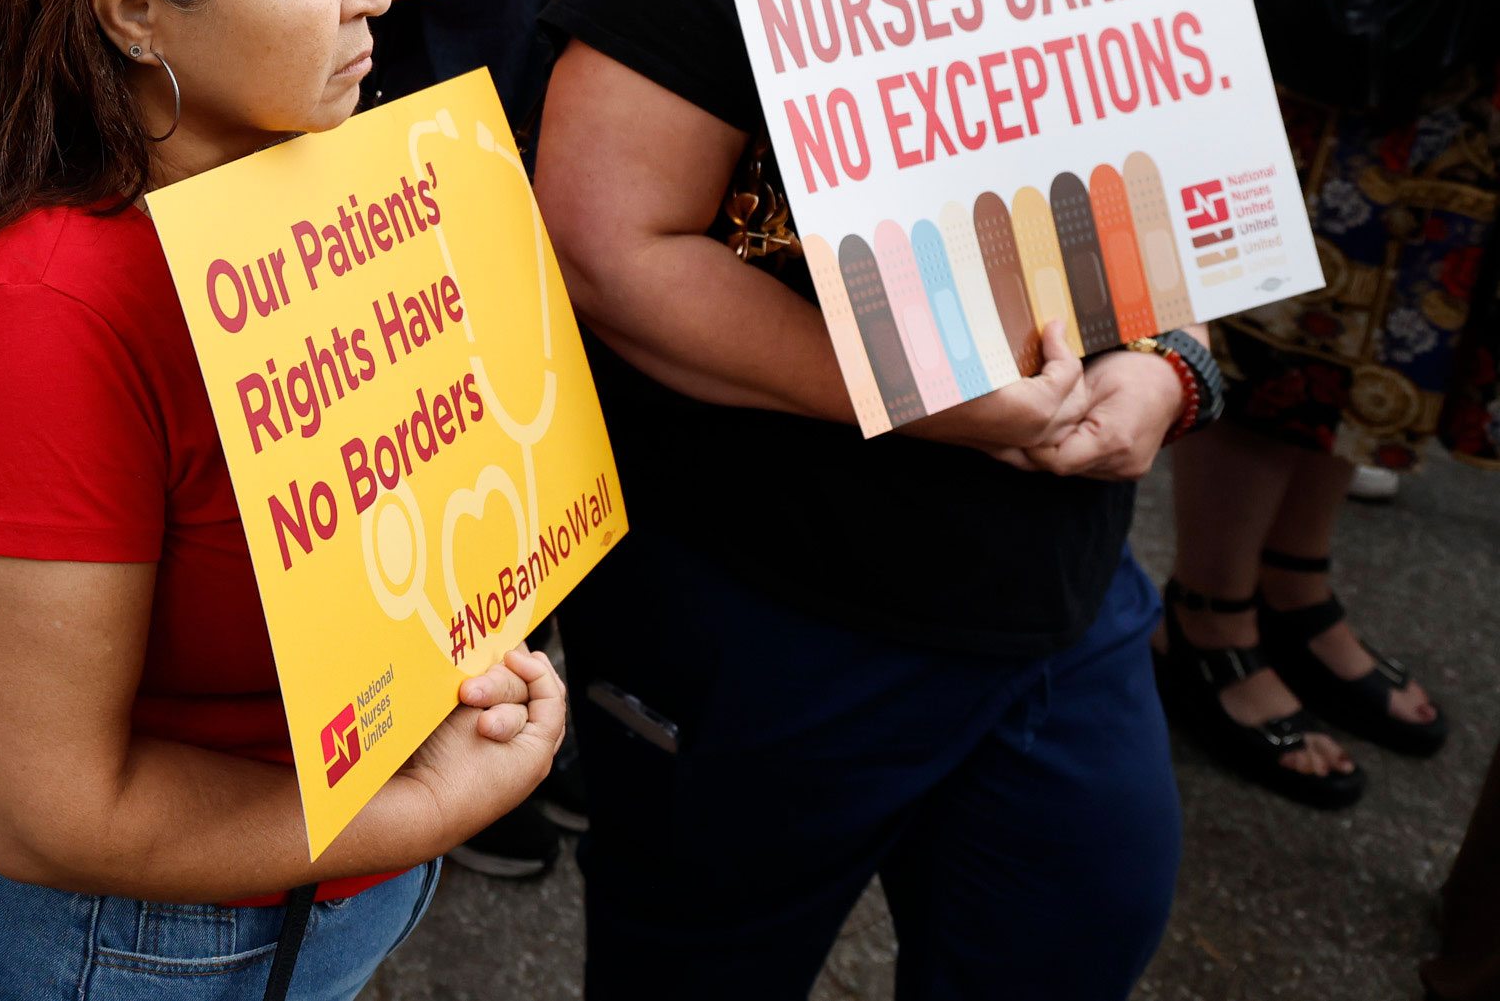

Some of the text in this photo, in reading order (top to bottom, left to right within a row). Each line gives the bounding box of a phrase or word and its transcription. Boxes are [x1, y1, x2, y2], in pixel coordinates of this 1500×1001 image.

[784, 12, 1230, 193] NO EXCEPTIONS.
[1226, 164, 1276, 186] National
[1230, 184, 1271, 201] Nurses
[1234, 198, 1274, 219] United
[1239, 215, 1278, 235] United
[207, 249, 290, 333] Our
[236, 276, 463, 454] Rights Have
[268, 374, 483, 570] No Borders
[450, 473, 612, 666] #NoBanNoWall
[356, 663, 394, 711] National
[360, 694, 391, 732] Nurses
[363, 710, 393, 751] United
